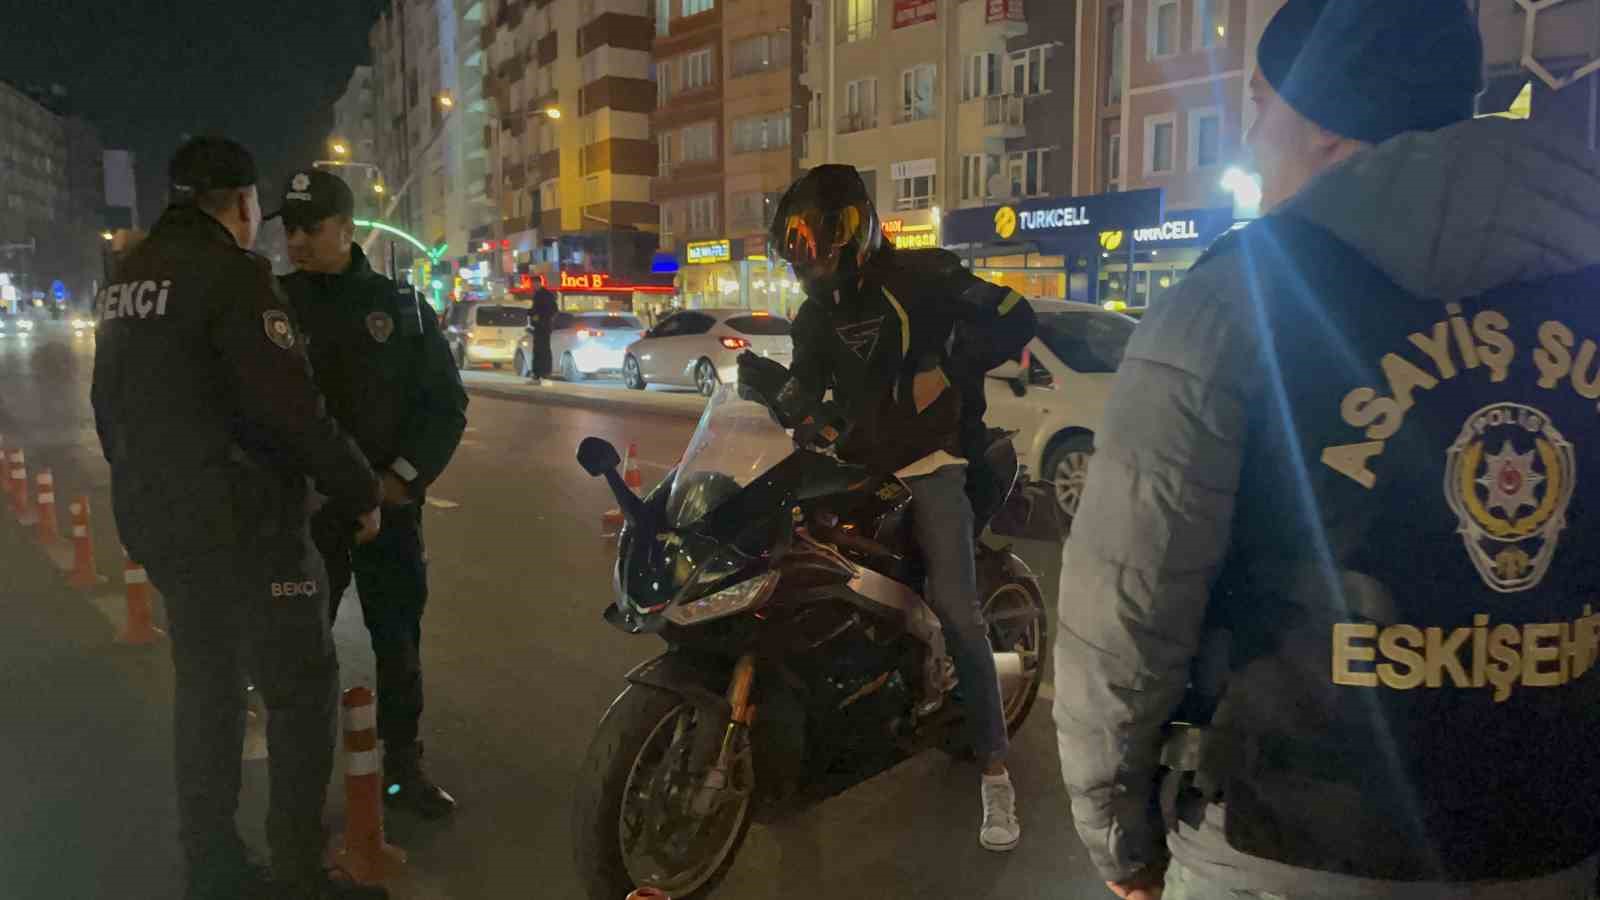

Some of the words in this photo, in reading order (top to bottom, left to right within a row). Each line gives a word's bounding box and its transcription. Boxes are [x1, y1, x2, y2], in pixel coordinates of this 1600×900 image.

[1019, 206, 1090, 230] TURKCELL
[1133, 220, 1199, 242] URKCELL
[1320, 303, 1515, 489] ASAYİŞ
[1533, 320, 1600, 399] ŞU
